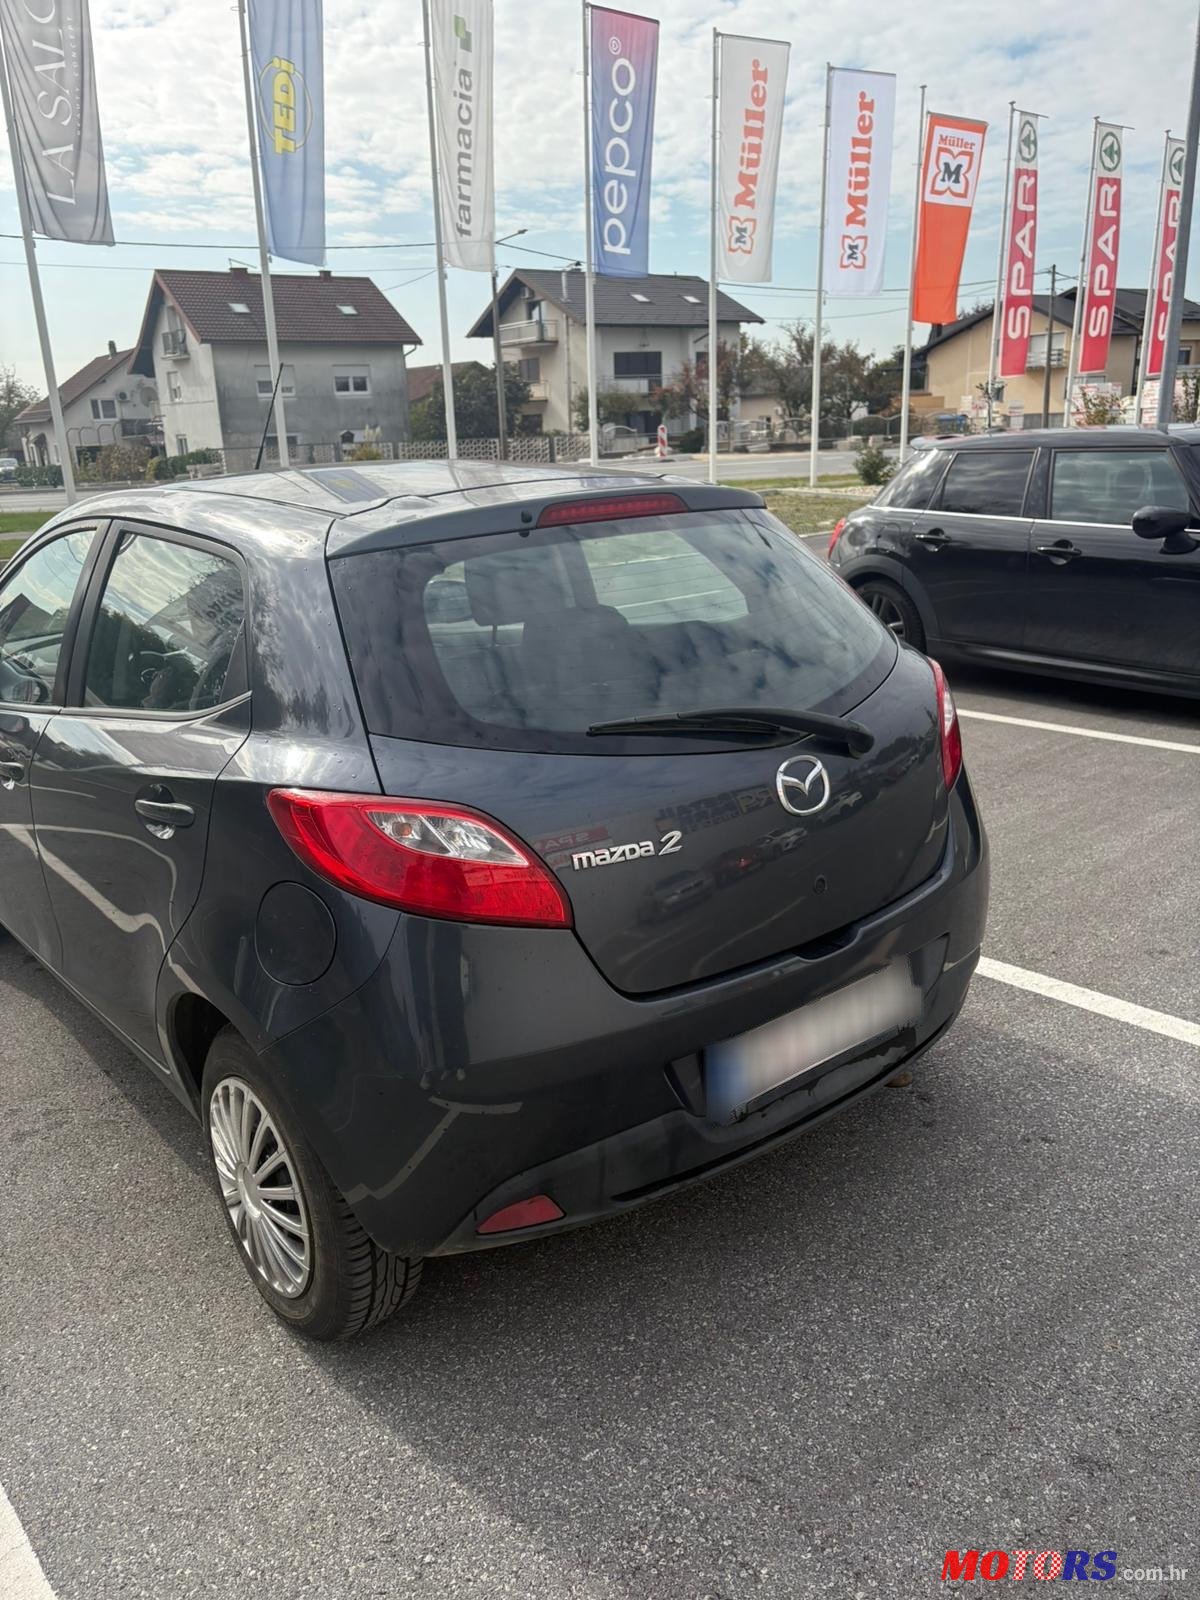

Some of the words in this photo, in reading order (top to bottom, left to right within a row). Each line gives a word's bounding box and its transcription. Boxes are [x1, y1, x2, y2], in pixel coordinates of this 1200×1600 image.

[42, 144, 76, 204] LA
[453, 70, 473, 238] farmacia
[734, 59, 769, 210] Müller
[845, 91, 875, 228] Müller
[938, 134, 976, 150] Müller
[941, 162, 963, 184] M
[1008, 175, 1036, 340] SPAR
[1088, 183, 1118, 338] SPAR
[658, 830, 682, 856] 2
